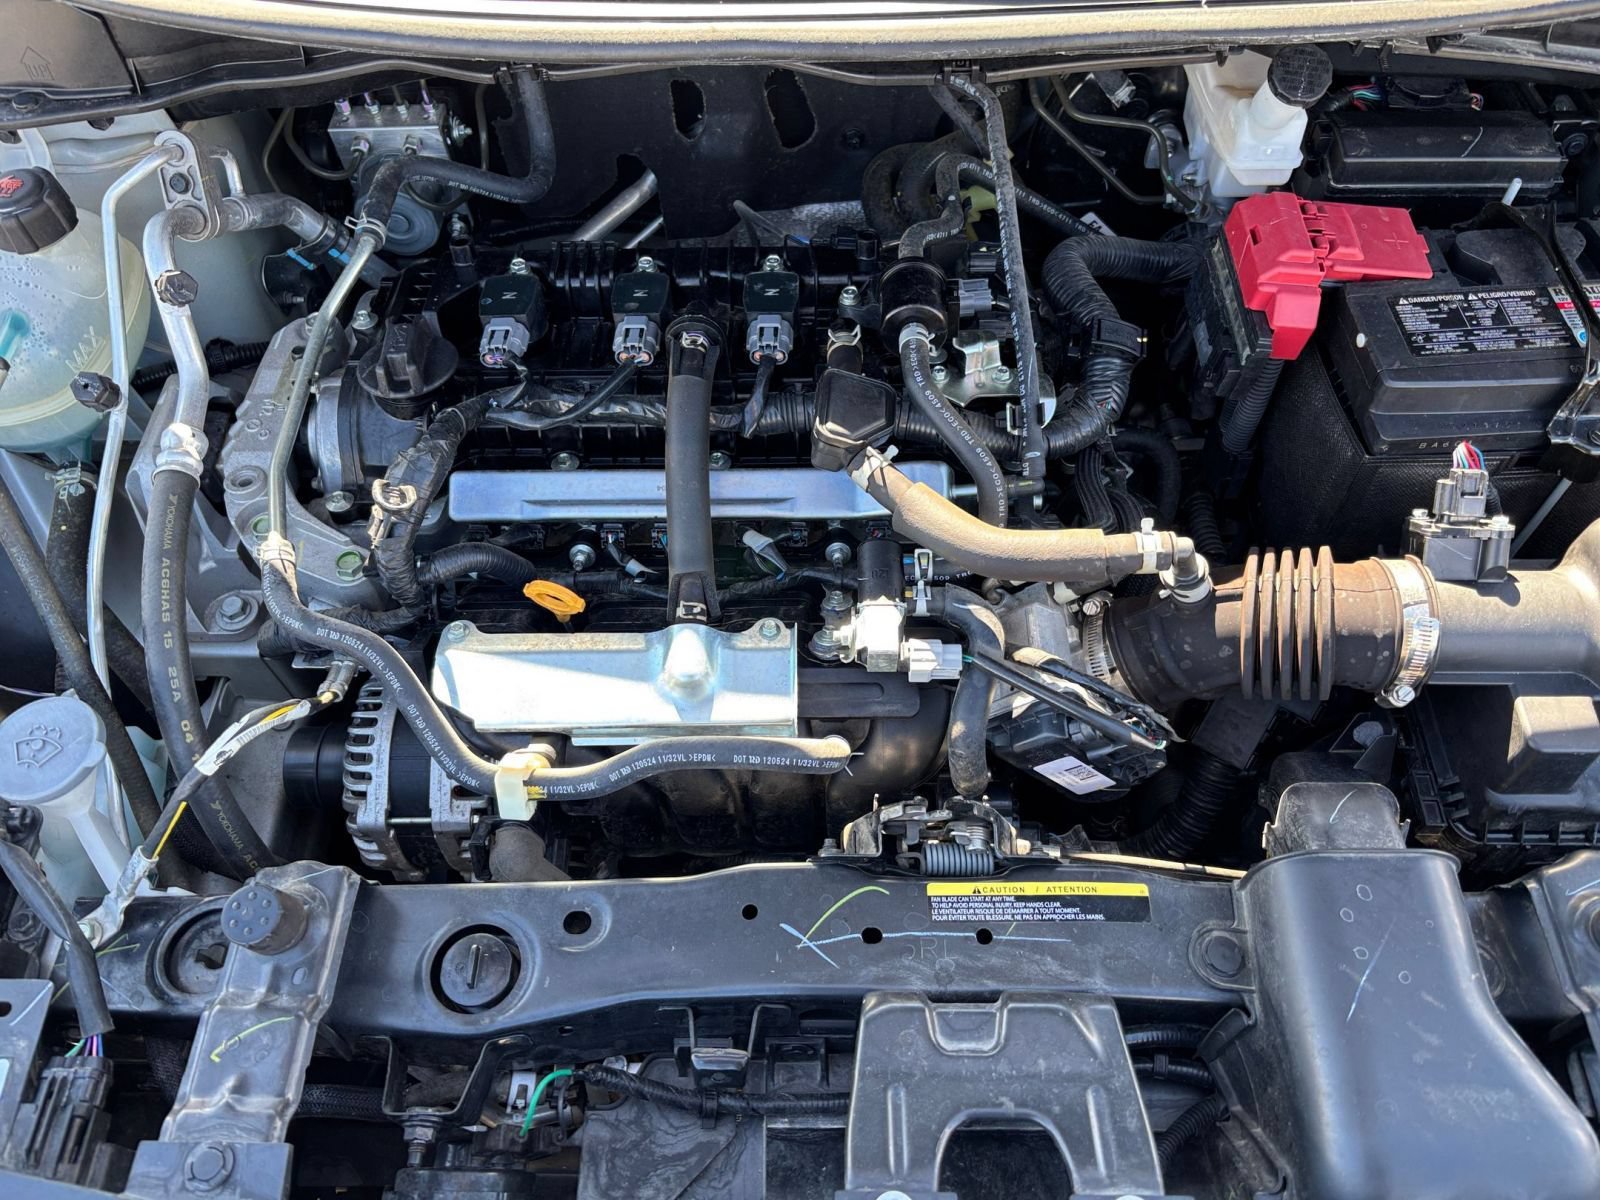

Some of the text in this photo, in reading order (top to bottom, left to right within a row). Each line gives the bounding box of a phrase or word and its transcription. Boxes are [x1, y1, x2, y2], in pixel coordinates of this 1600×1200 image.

[1408, 294, 1464, 304] DANGER/POISON
[1477, 290, 1536, 299] PELIGRO/VENENO
[163, 505, 177, 550] YOKOHAMA
[163, 630, 174, 649] 15
[316, 627, 328, 637] DOT
[341, 635, 364, 651] 120524
[168, 666, 182, 703] 25A
[407, 704, 419, 717] DOT
[422, 728, 439, 752] 120524
[608, 772, 621, 782] DOT
[631, 758, 657, 772] 120524
[733, 754, 747, 763] DOT
[763, 756, 790, 766] 120524
[216, 812, 244, 850] YOKOHAMA
[982, 886, 1025, 894] CAUTION
